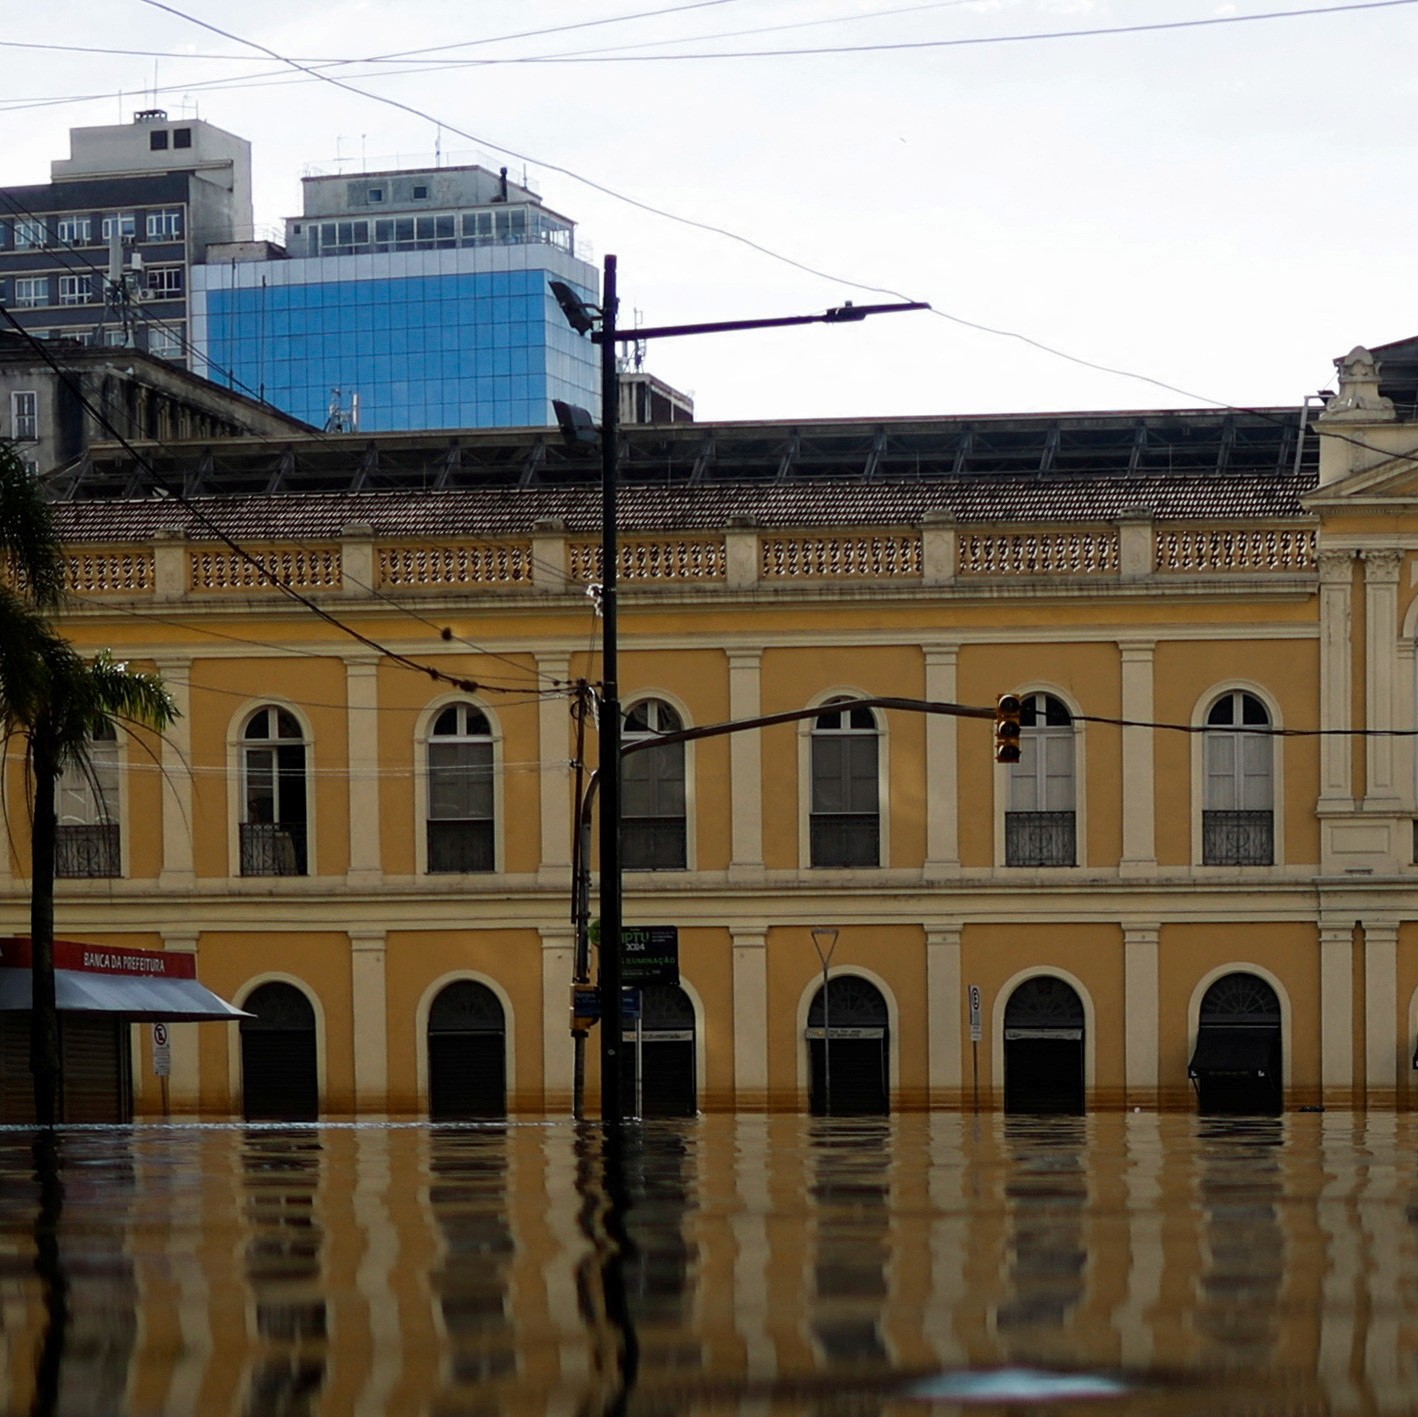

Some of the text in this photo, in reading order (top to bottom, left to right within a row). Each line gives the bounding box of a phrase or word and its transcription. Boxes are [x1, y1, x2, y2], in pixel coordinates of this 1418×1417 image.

[84, 953, 165, 972] BANCA DA PREFEITURA
